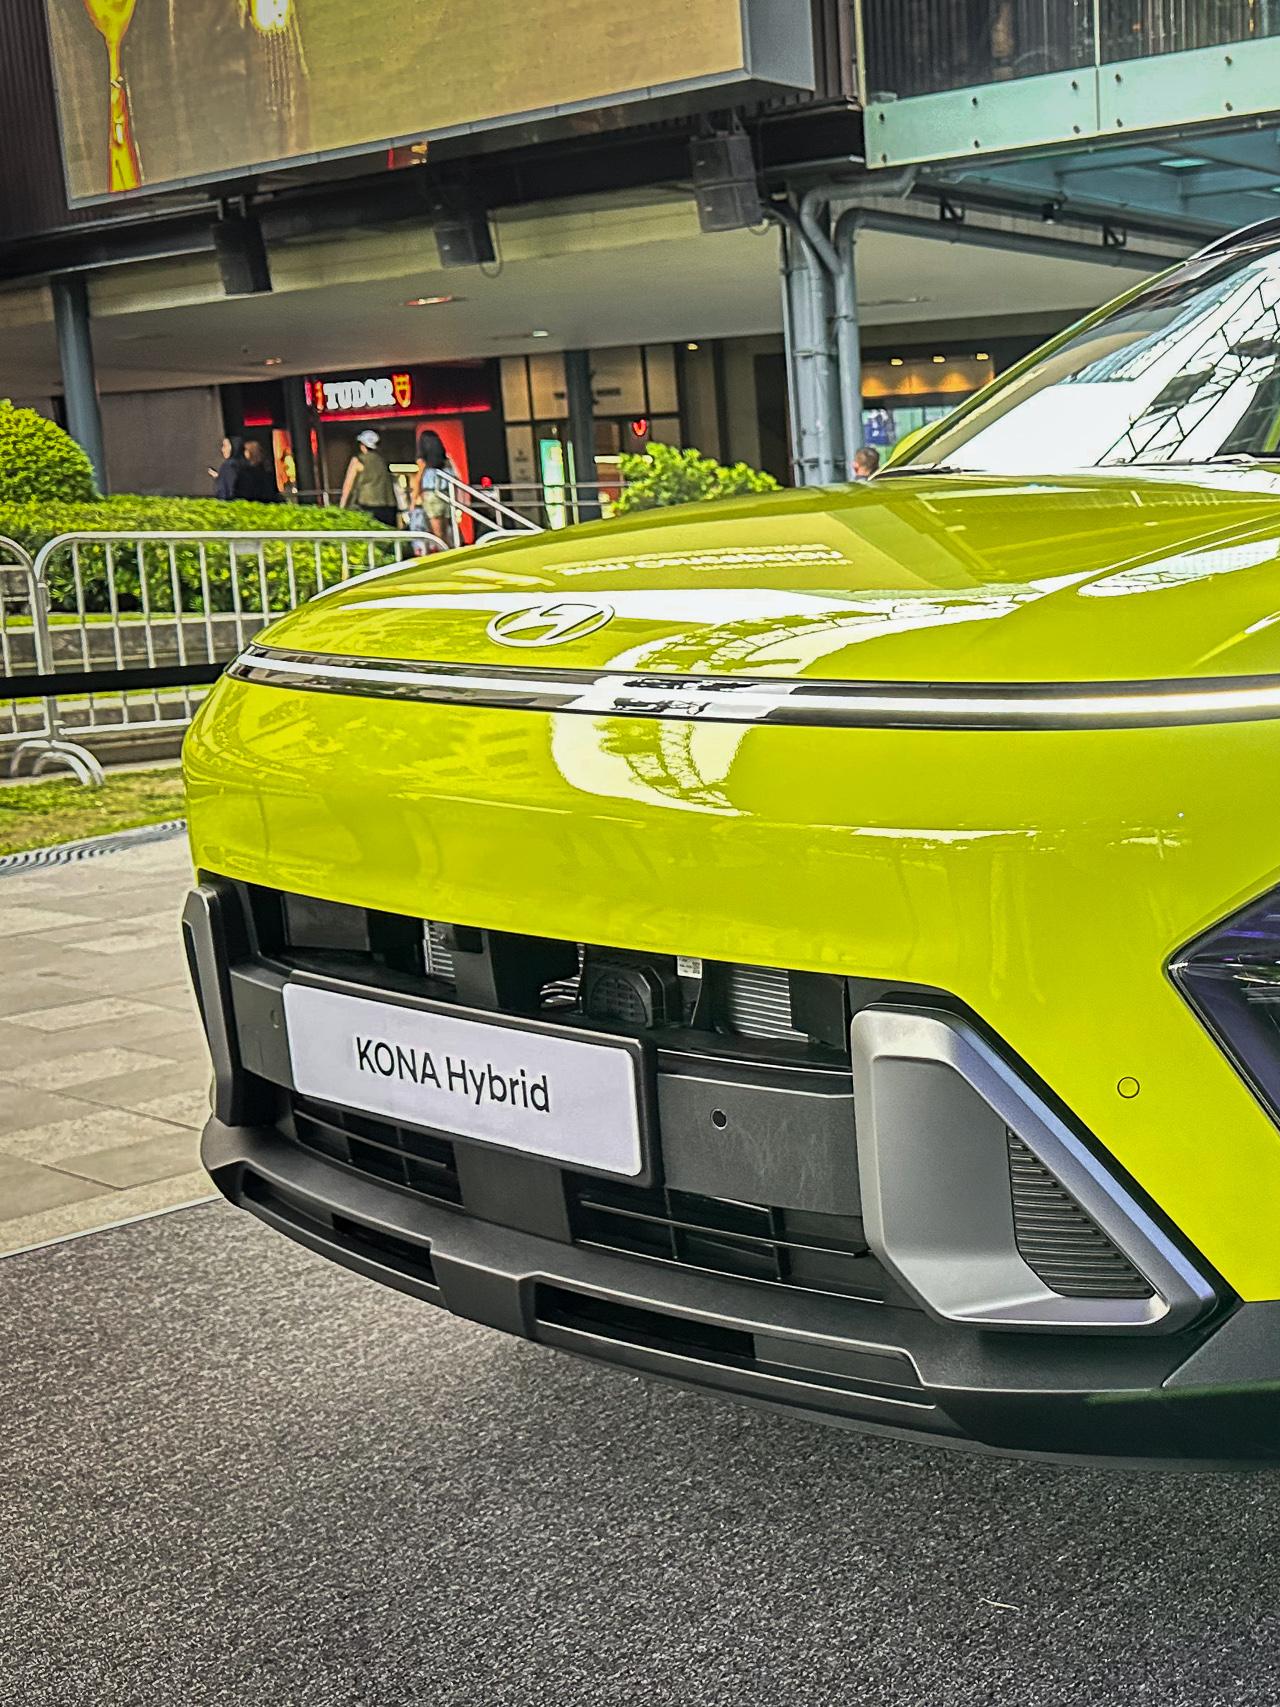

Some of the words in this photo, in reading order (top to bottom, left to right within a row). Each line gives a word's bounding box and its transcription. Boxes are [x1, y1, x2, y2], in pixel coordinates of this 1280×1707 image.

[323, 378, 396, 410] TUDOR
[356, 1037, 442, 1089] KONA
[446, 1056, 551, 1113] Hybrid
